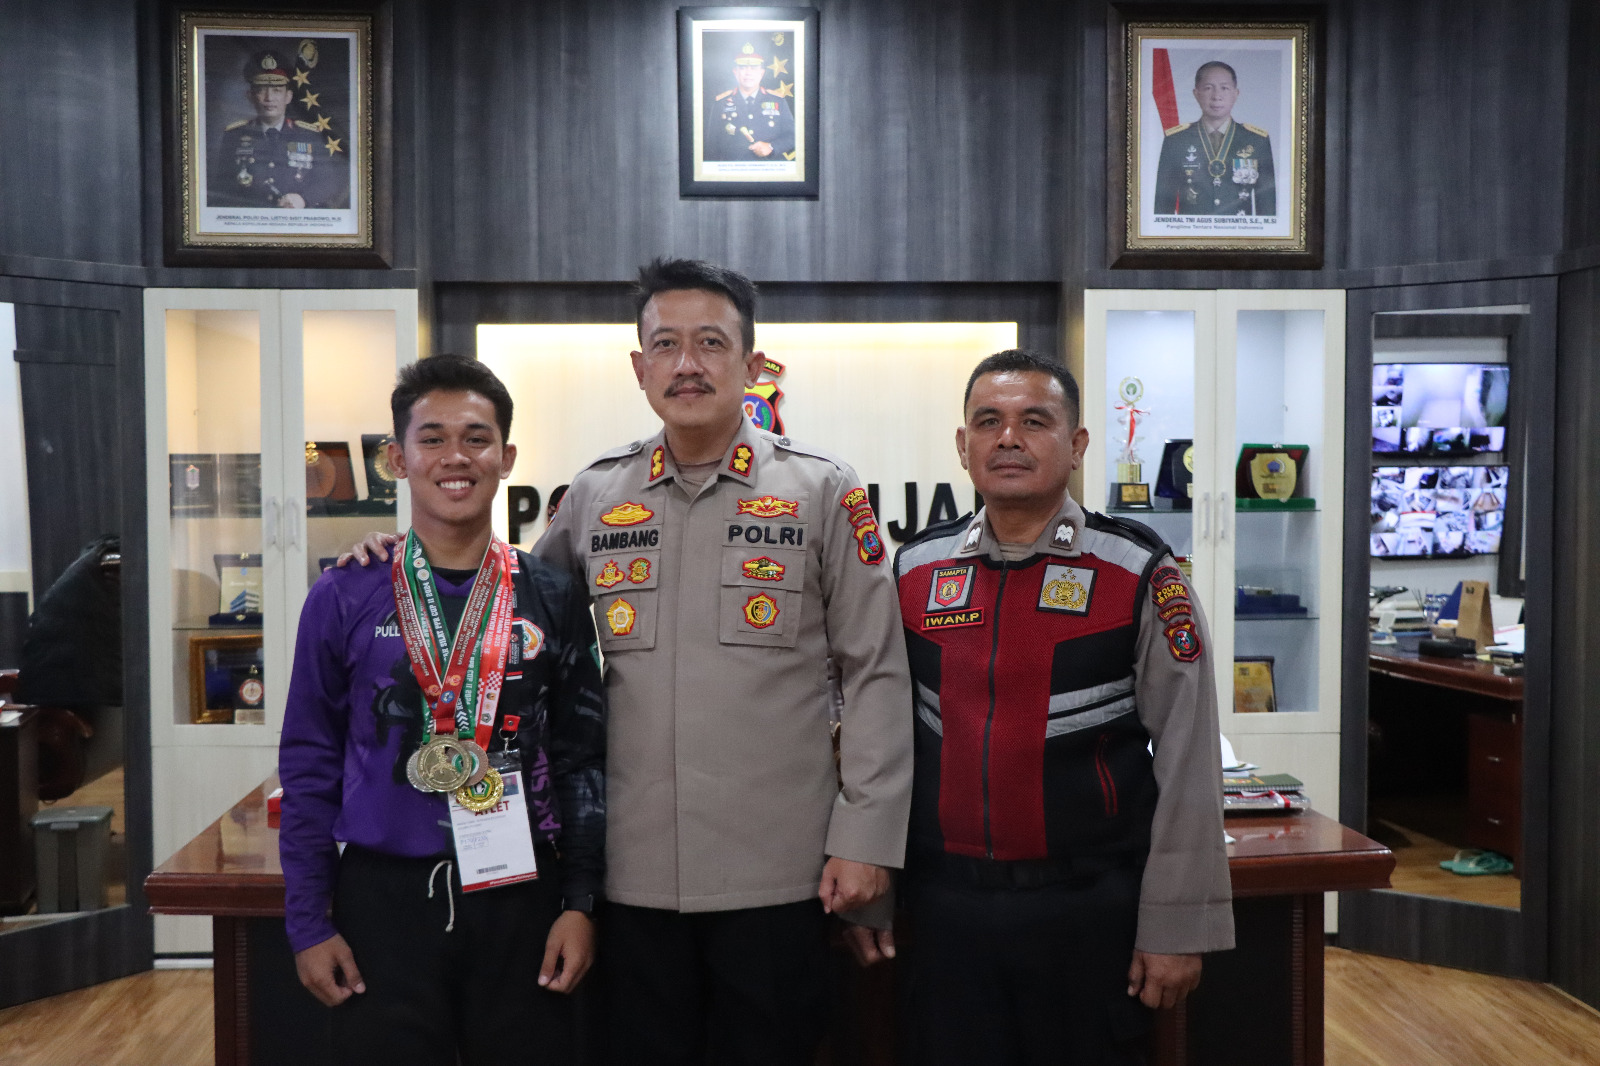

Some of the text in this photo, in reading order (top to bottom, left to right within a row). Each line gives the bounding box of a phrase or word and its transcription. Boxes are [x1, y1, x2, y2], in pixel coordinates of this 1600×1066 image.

[764, 361, 780, 373] ARA
[592, 529, 658, 552] BAMBANG
[728, 524, 803, 546] POLRI
[939, 568, 967, 577] SAMAPTA
[428, 603, 438, 616] CUP
[926, 612, 980, 628] IWAN.P
[375, 626, 400, 638] PULL
[436, 629, 447, 647] SILAT
[409, 646, 418, 663] 2025
[456, 628, 471, 665] INDONESIA
[412, 640, 429, 676] INDONESIA
